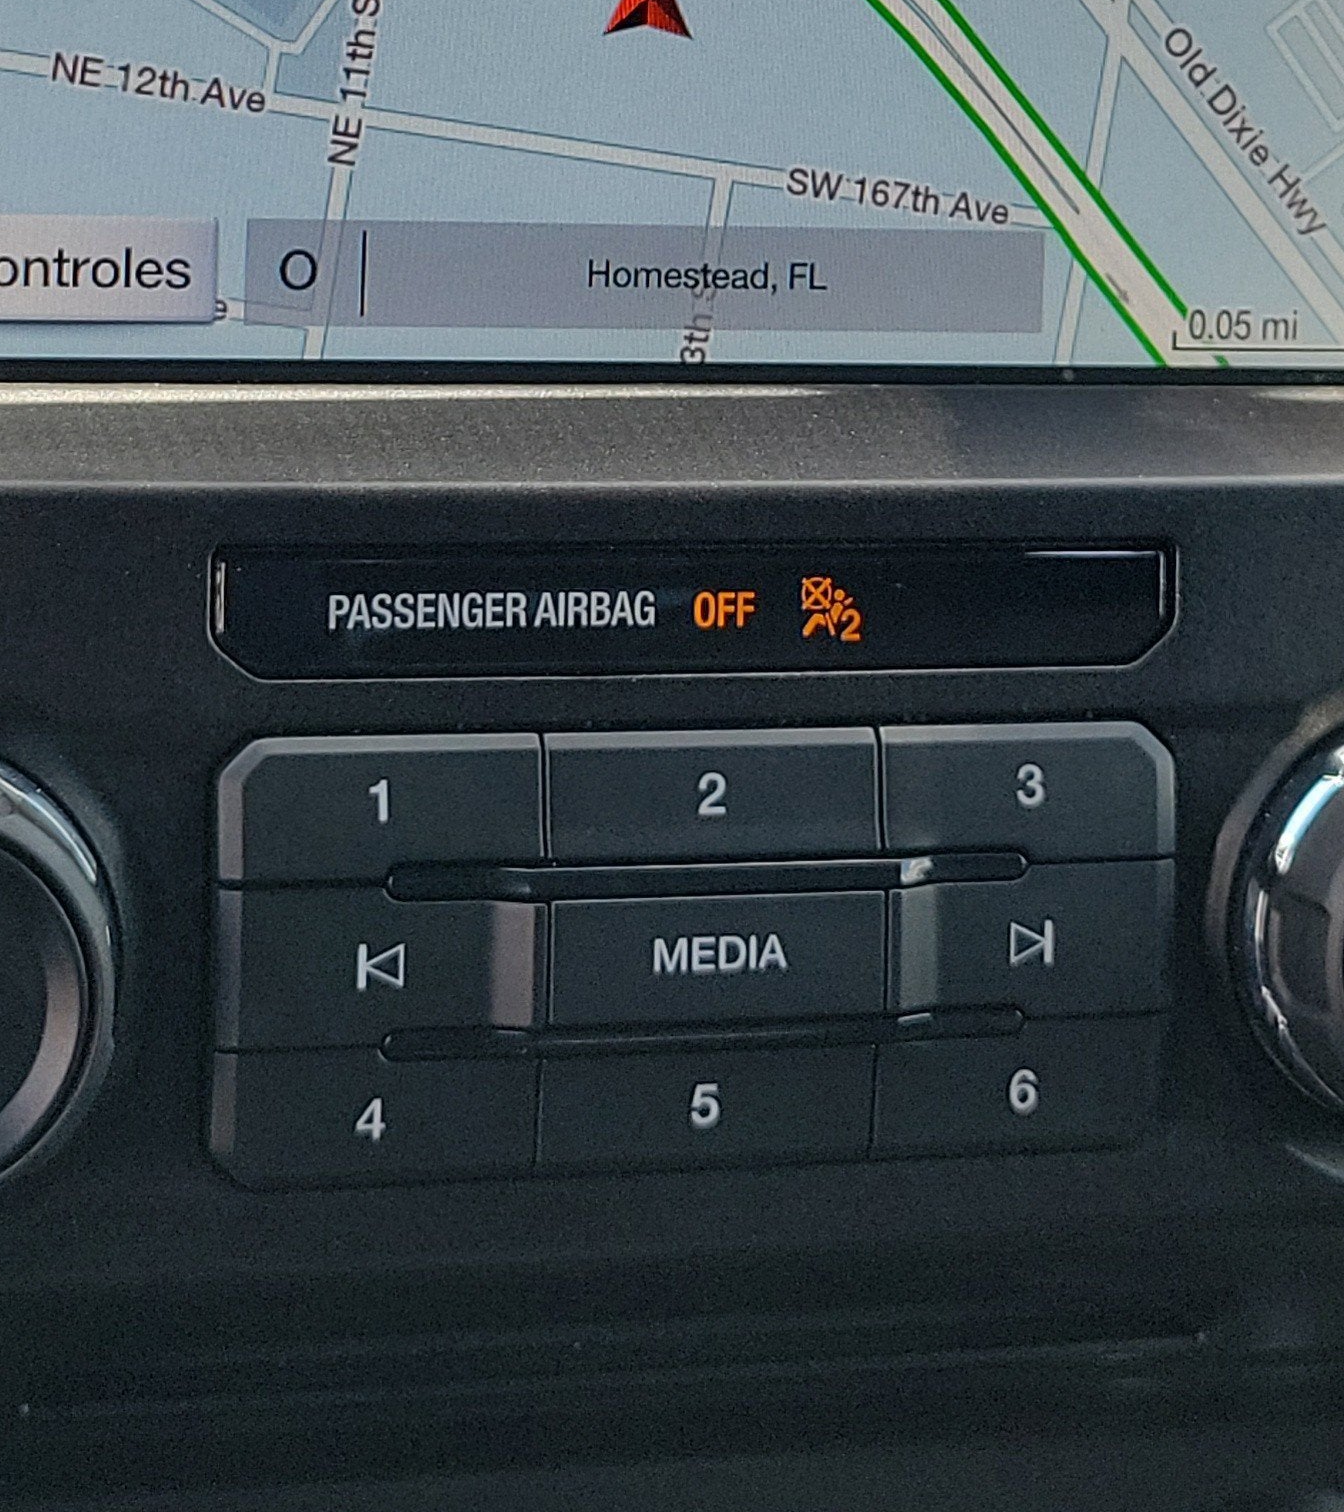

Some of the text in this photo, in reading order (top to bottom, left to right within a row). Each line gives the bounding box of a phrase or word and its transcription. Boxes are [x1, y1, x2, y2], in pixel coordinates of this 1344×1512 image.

[52, 52, 267, 115] NE 12th Ave
[340, 28, 377, 104] 11th
[326, 114, 363, 167] NE
[1164, 27, 1327, 236] Old Dixie Hwy
[786, 168, 1010, 225] SW 167th Ave
[279, 249, 318, 290] O
[587, 259, 778, 295] Homestead,
[788, 262, 828, 290] FL
[1188, 309, 1298, 340] 0.05 mi
[328, 590, 756, 630] PASSENGER AIRBAG OFF
[368, 780, 391, 823] 1
[697, 772, 727, 816] 2
[1015, 763, 1046, 808] 3
[652, 933, 788, 976] MEDIA
[689, 1085, 721, 1129] 5
[1007, 1068, 1040, 1112] 6
[353, 1098, 386, 1141] 4
